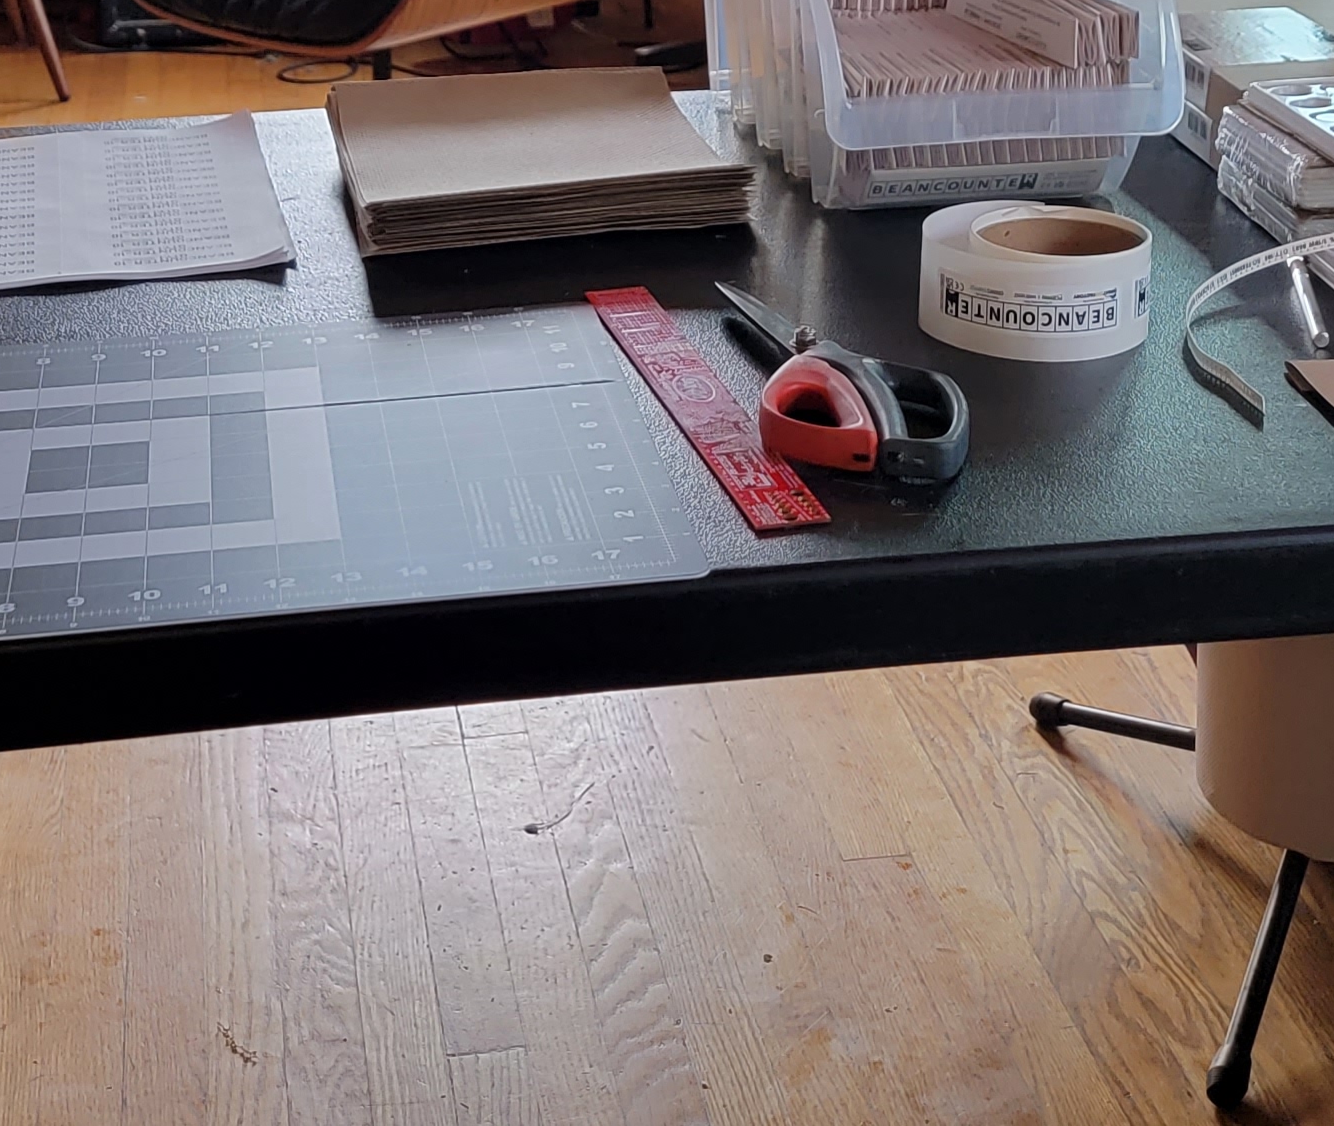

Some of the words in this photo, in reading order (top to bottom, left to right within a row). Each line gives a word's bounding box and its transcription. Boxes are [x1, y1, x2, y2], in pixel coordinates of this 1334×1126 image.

[872, 174, 1034, 195] BEANCOUNTER
[947, 300, 1115, 327] BEANCOUNTER
[543, 325, 561, 334] 11
[549, 342, 568, 353] 10
[587, 442, 607, 450] 5
[604, 486, 625, 495] 3
[613, 510, 635, 518] 2
[67, 596, 84, 606] 9
[128, 589, 161, 601] 10
[198, 583, 228, 595] 11
[263, 577, 297, 589] 12
[331, 572, 363, 583] 13
[396, 566, 428, 577] 14
[462, 560, 493, 572] 15
[528, 555, 558, 566] 16
[591, 549, 620, 560] 17
